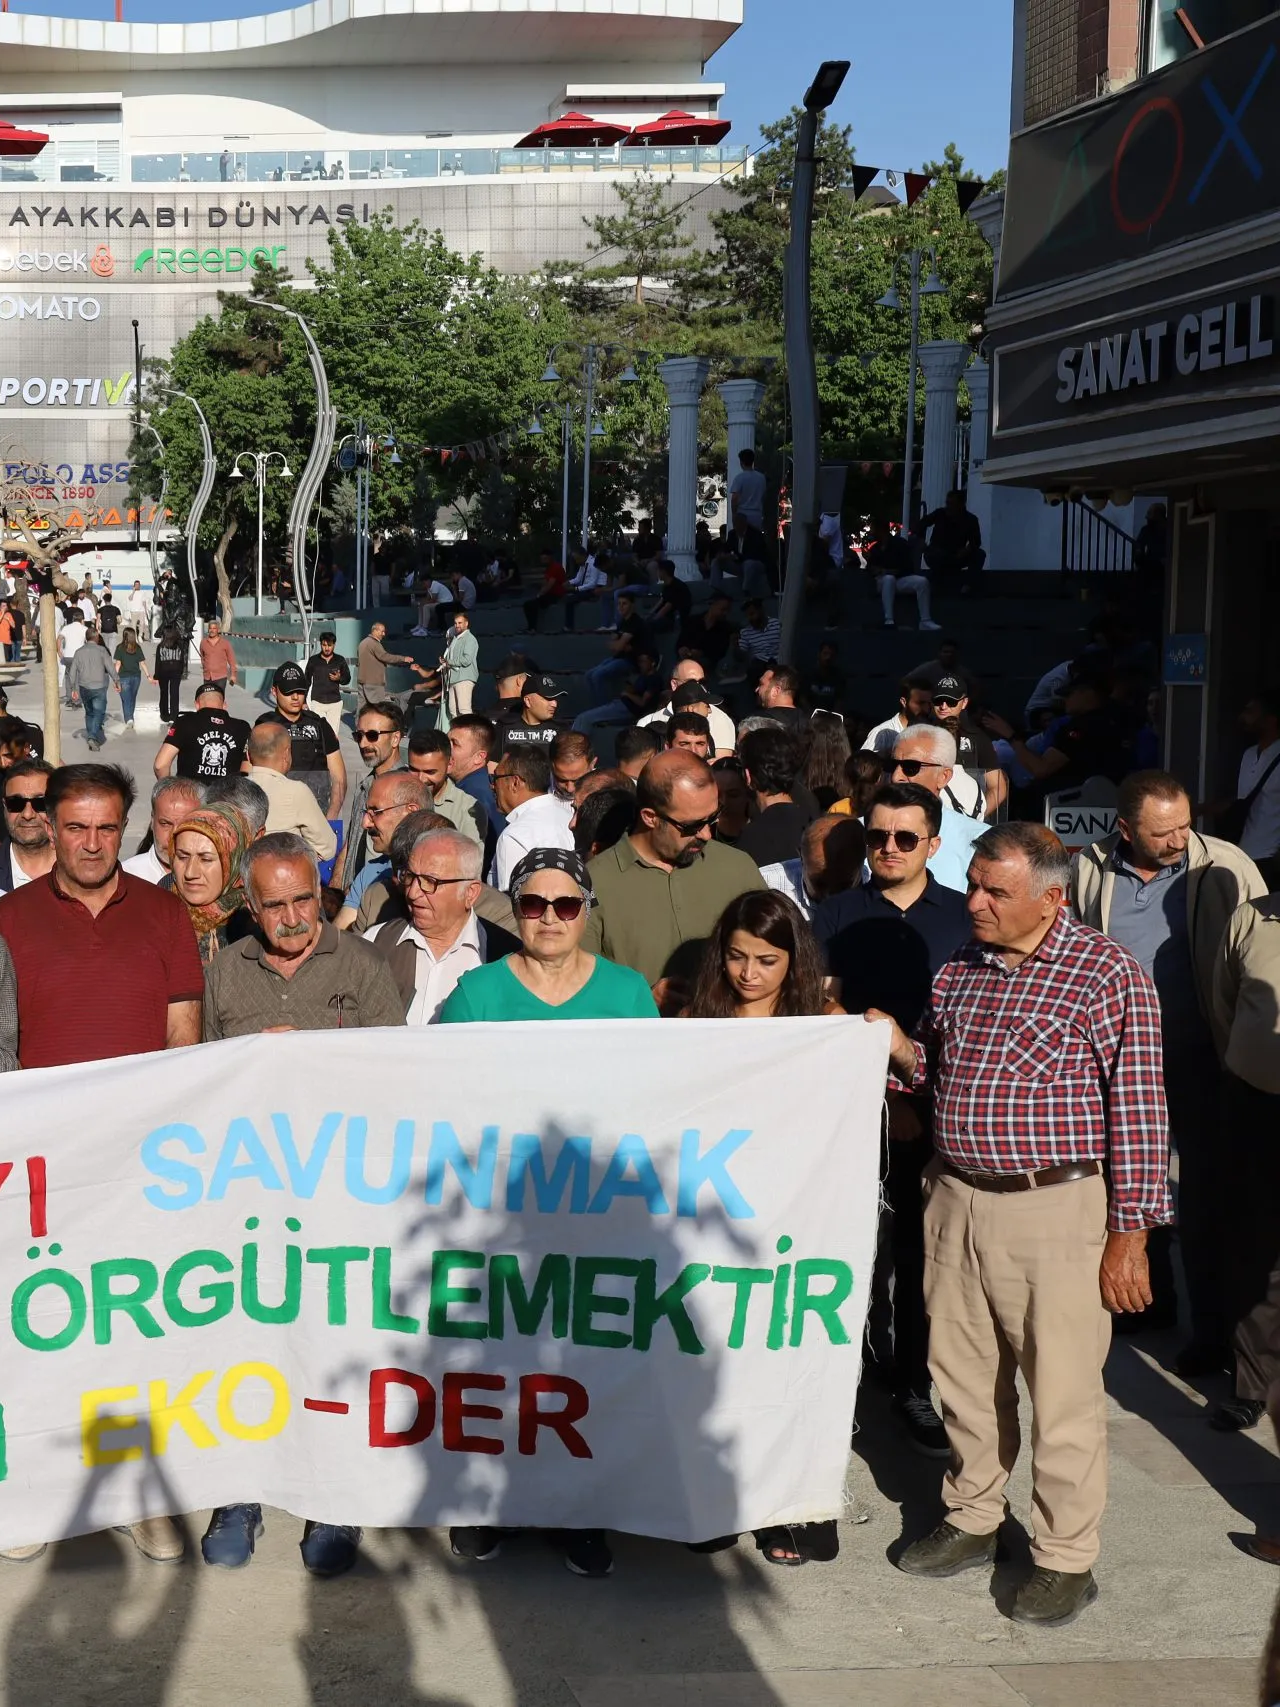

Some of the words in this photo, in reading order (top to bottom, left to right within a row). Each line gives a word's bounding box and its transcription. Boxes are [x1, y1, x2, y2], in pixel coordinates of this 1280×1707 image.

[9, 206, 189, 228] AYAKKABI
[208, 200, 368, 228] DÜNYASI
[1056, 321, 1167, 403] SANAT
[1176, 295, 1273, 376] CELL
[62, 487, 95, 499] 1890
[97, 569, 112, 579] T-4
[197, 731, 220, 746] ÖZEL
[223, 732, 237, 749] TİM
[508, 729, 527, 740] ÖZEL
[197, 764, 227, 777] POLİS
[140, 1111, 756, 1219] SAVUNMAK
[10, 1216, 853, 1357] ÖRGÜTLEMEKTİR
